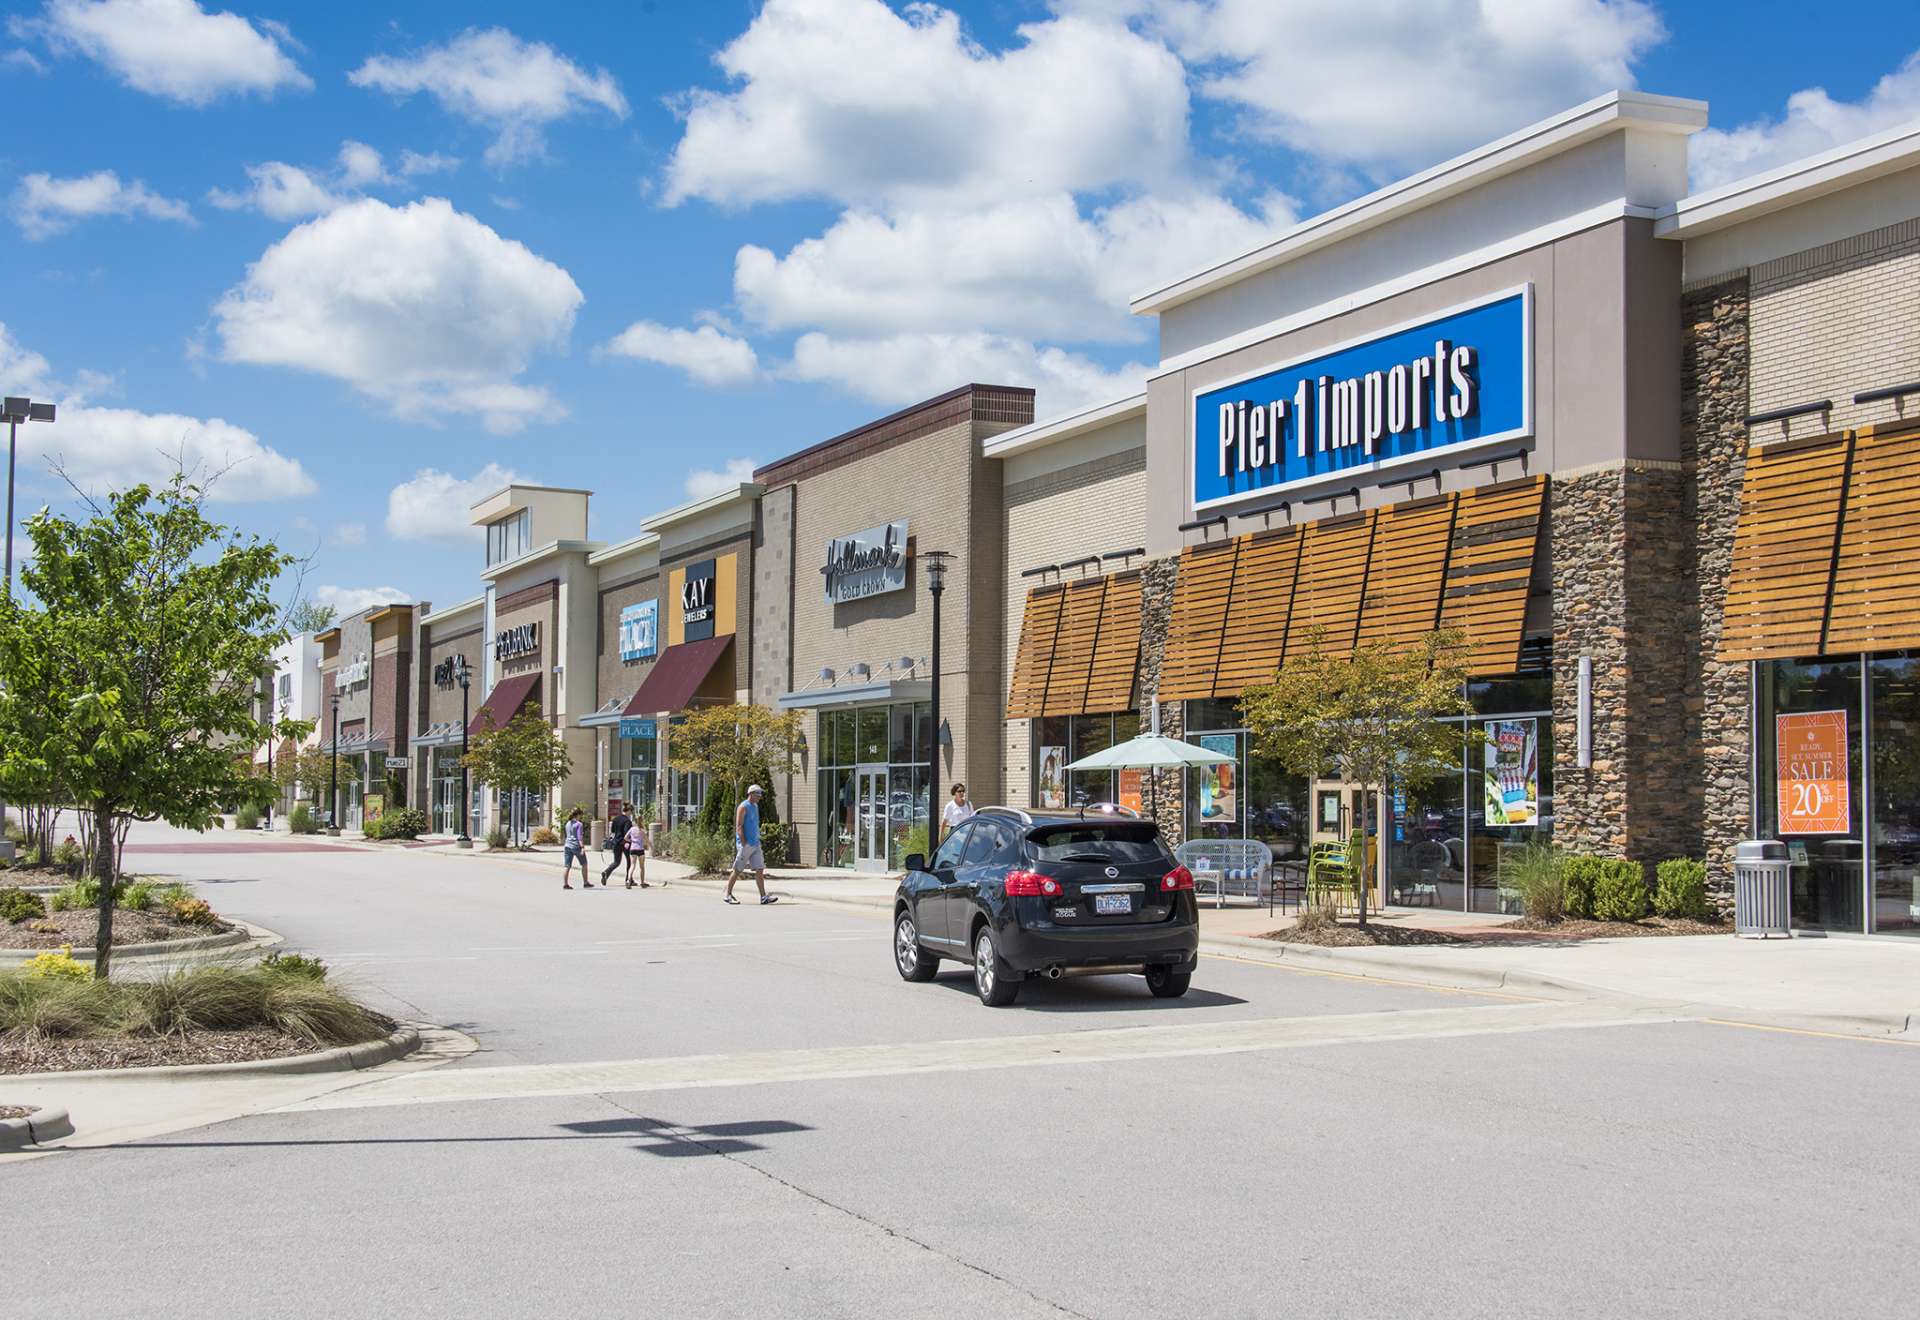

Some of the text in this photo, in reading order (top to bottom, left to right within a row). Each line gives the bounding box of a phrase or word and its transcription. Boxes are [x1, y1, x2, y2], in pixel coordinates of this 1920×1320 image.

[1219, 339, 1477, 477] Pier 1 imports
[819, 524, 900, 598] Hallmark
[681, 577, 708, 610] KAY
[841, 579, 886, 600] GOLD CROWN
[681, 609, 708, 624] JEWELERS
[621, 726, 654, 736] PLACE
[386, 759, 406, 767] rue21
[1790, 760, 1834, 781] SALE
[1791, 783, 1822, 816] 20
